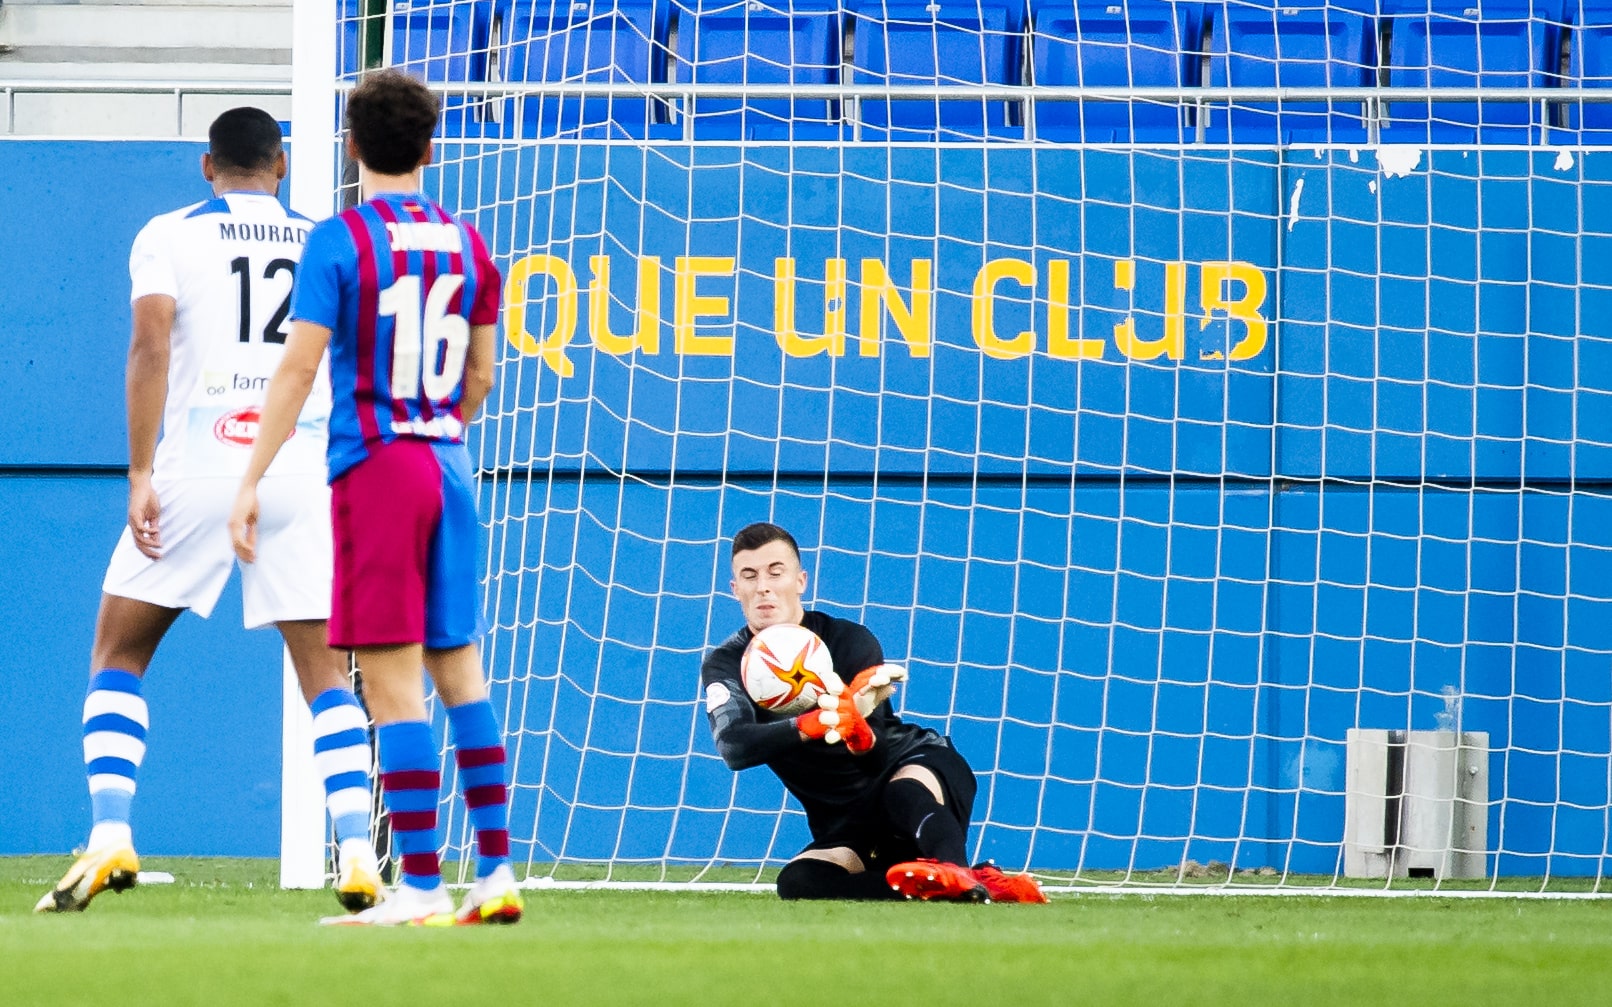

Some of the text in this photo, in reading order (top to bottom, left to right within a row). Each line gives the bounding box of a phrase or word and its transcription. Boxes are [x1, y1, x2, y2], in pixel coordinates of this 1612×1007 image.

[219, 222, 309, 245] MOURAD
[230, 256, 297, 344] 12
[379, 274, 471, 401] 16
[503, 254, 1268, 378] QUE UN CLUB
